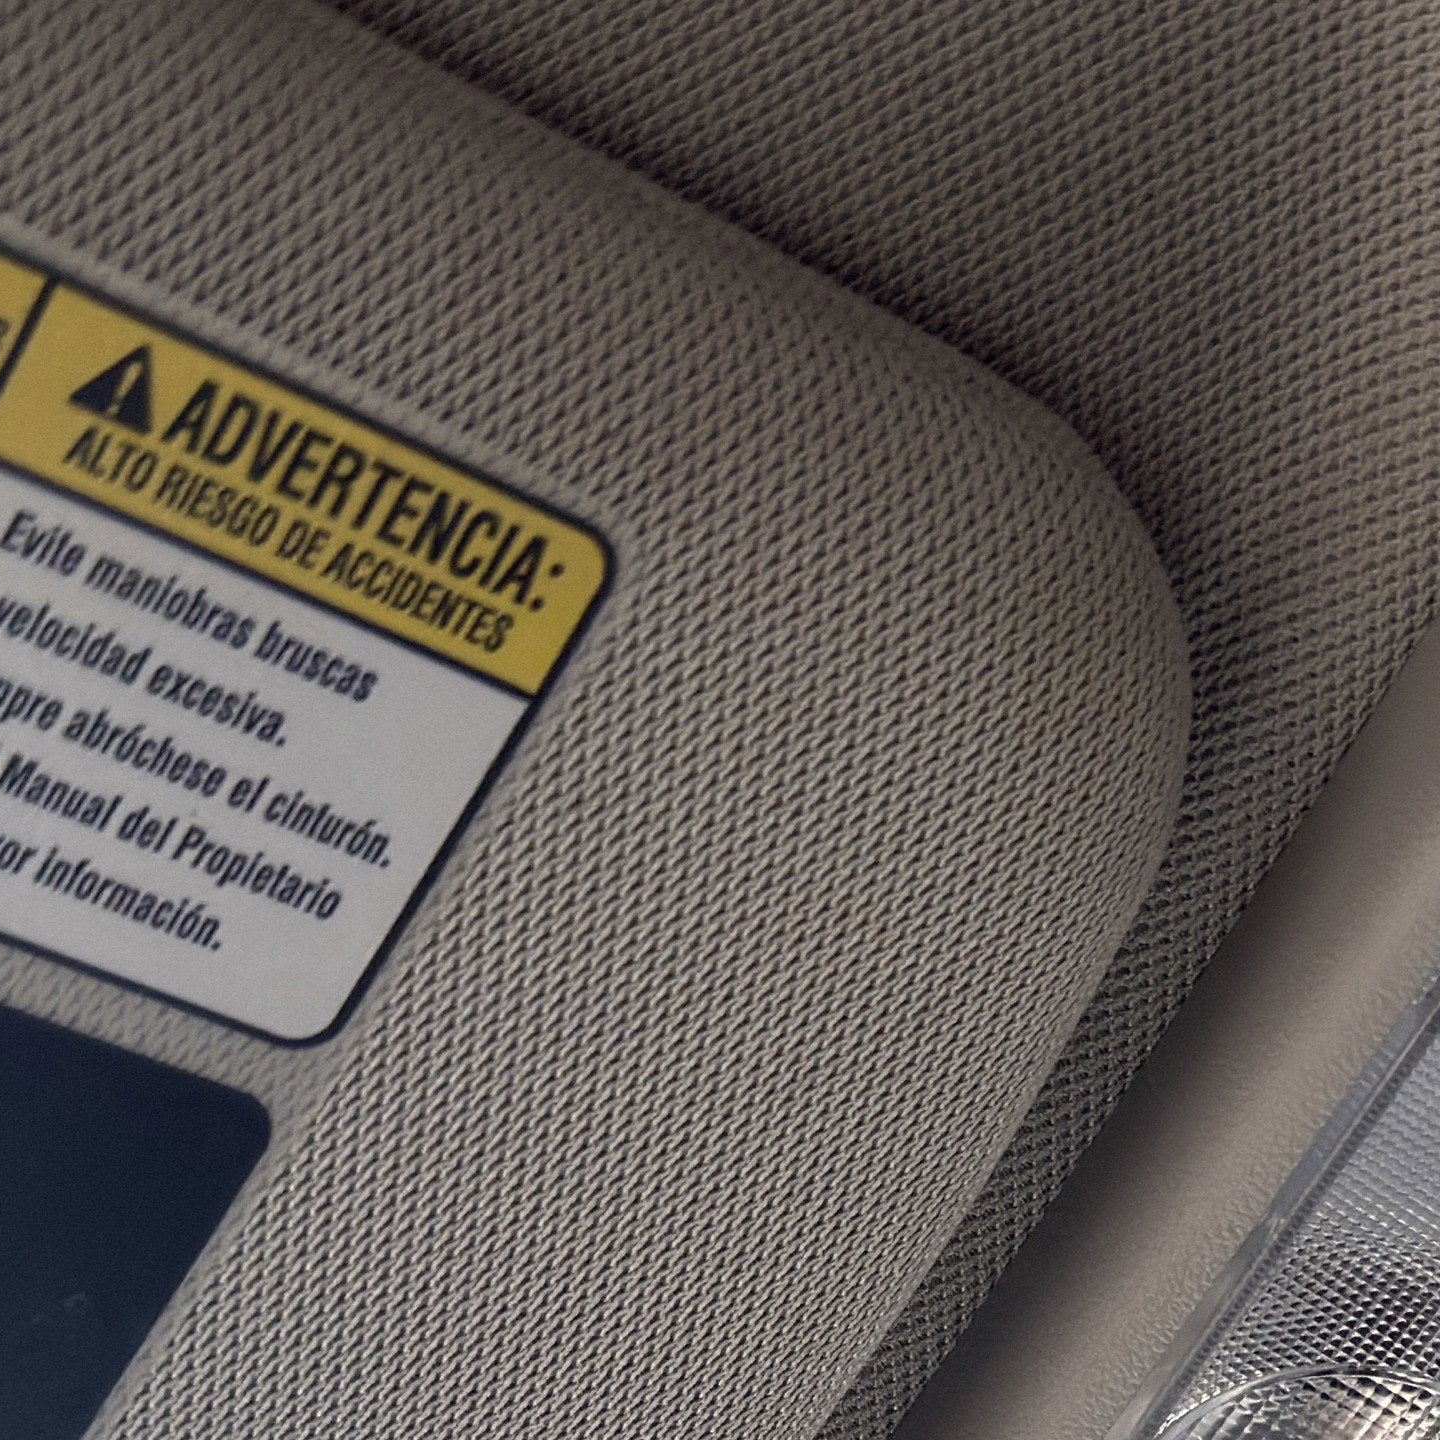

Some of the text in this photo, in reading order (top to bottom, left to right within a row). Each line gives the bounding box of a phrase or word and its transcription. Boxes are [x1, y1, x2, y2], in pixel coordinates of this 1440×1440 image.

[62, 424, 514, 653] ALTO RIESGO DE ACCIDENTES
[160, 379, 564, 611] ADVERTENCIA:
[84, 555, 256, 649] maniobras
[253, 619, 378, 702] bruscas
[145, 663, 285, 747] excesiva.
[62, 709, 227, 798] abróchese
[226, 776, 270, 813] el
[262, 790, 390, 868] cinturón.
[33, 846, 221, 951] información.
[116, 805, 178, 853] del
[170, 824, 342, 920] Propietario
